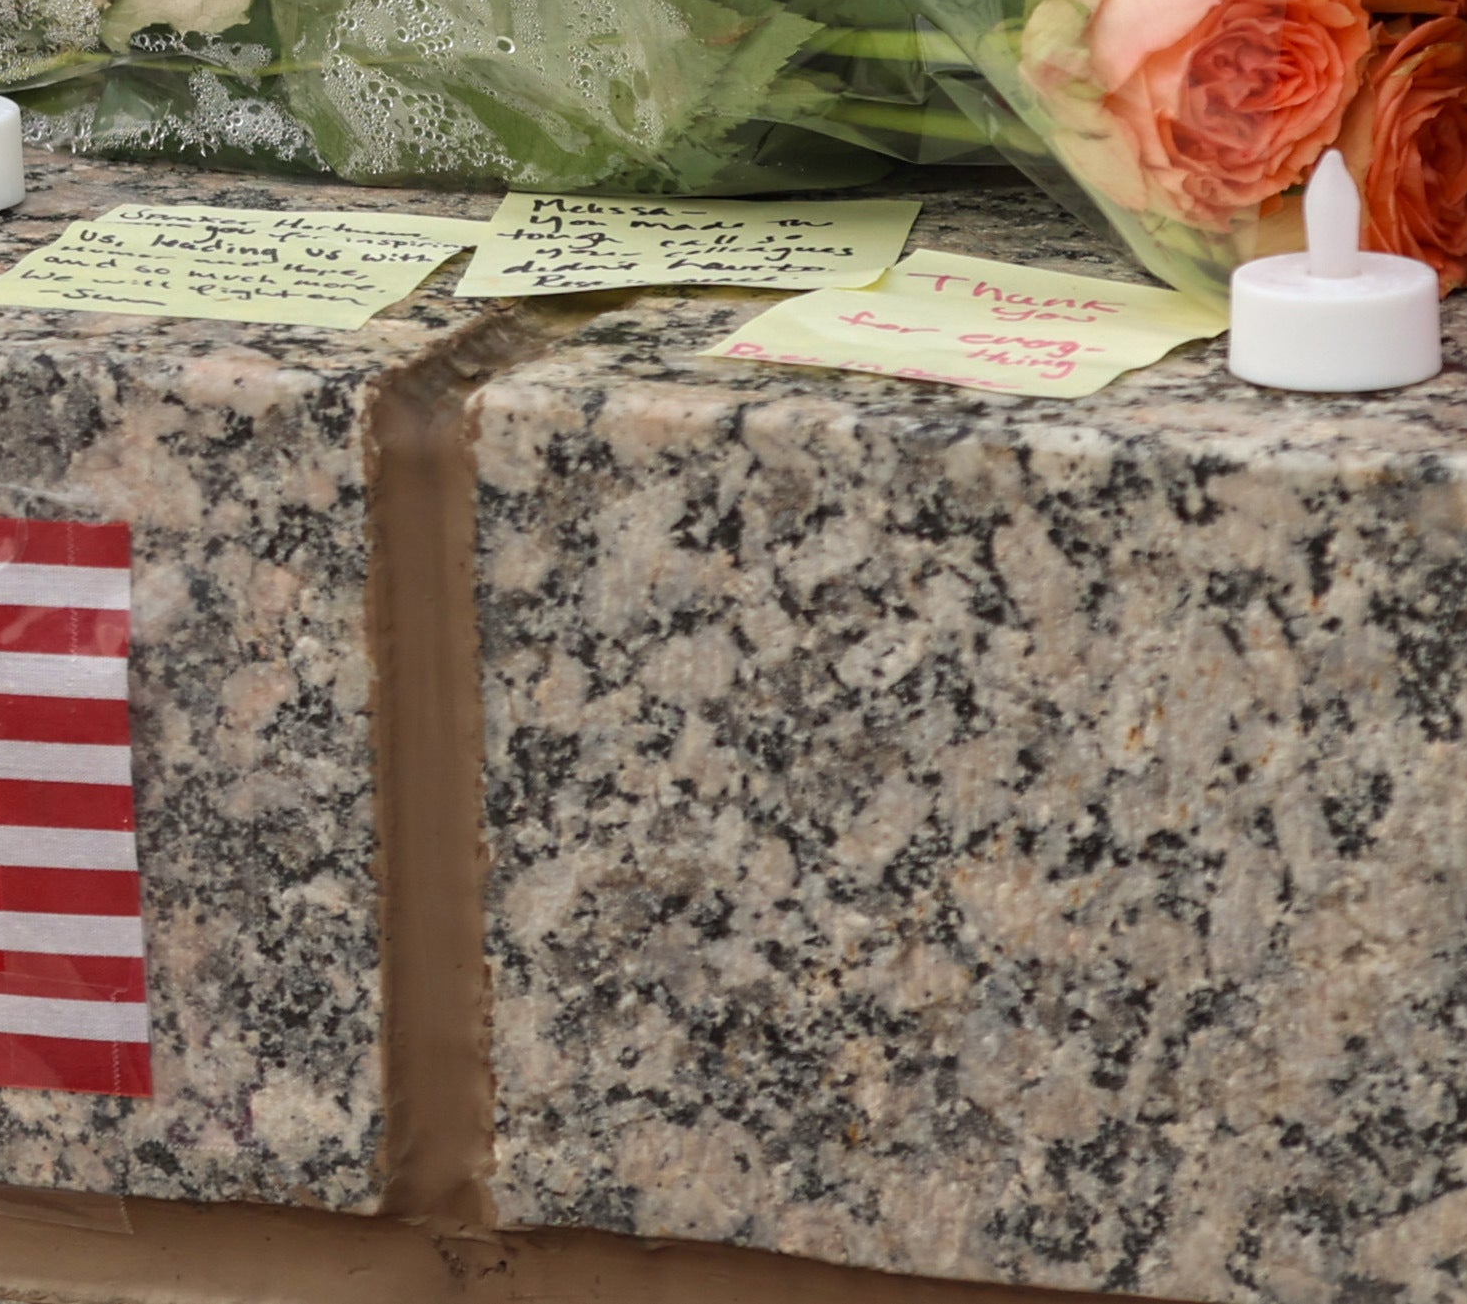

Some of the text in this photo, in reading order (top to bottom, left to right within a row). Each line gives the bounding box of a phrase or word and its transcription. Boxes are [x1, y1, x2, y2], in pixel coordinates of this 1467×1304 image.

[151, 233, 279, 264] leading
[44, 256, 118, 268] and
[188, 269, 277, 285] much
[907, 272, 1127, 314] Thank
[838, 309, 940, 334] for
